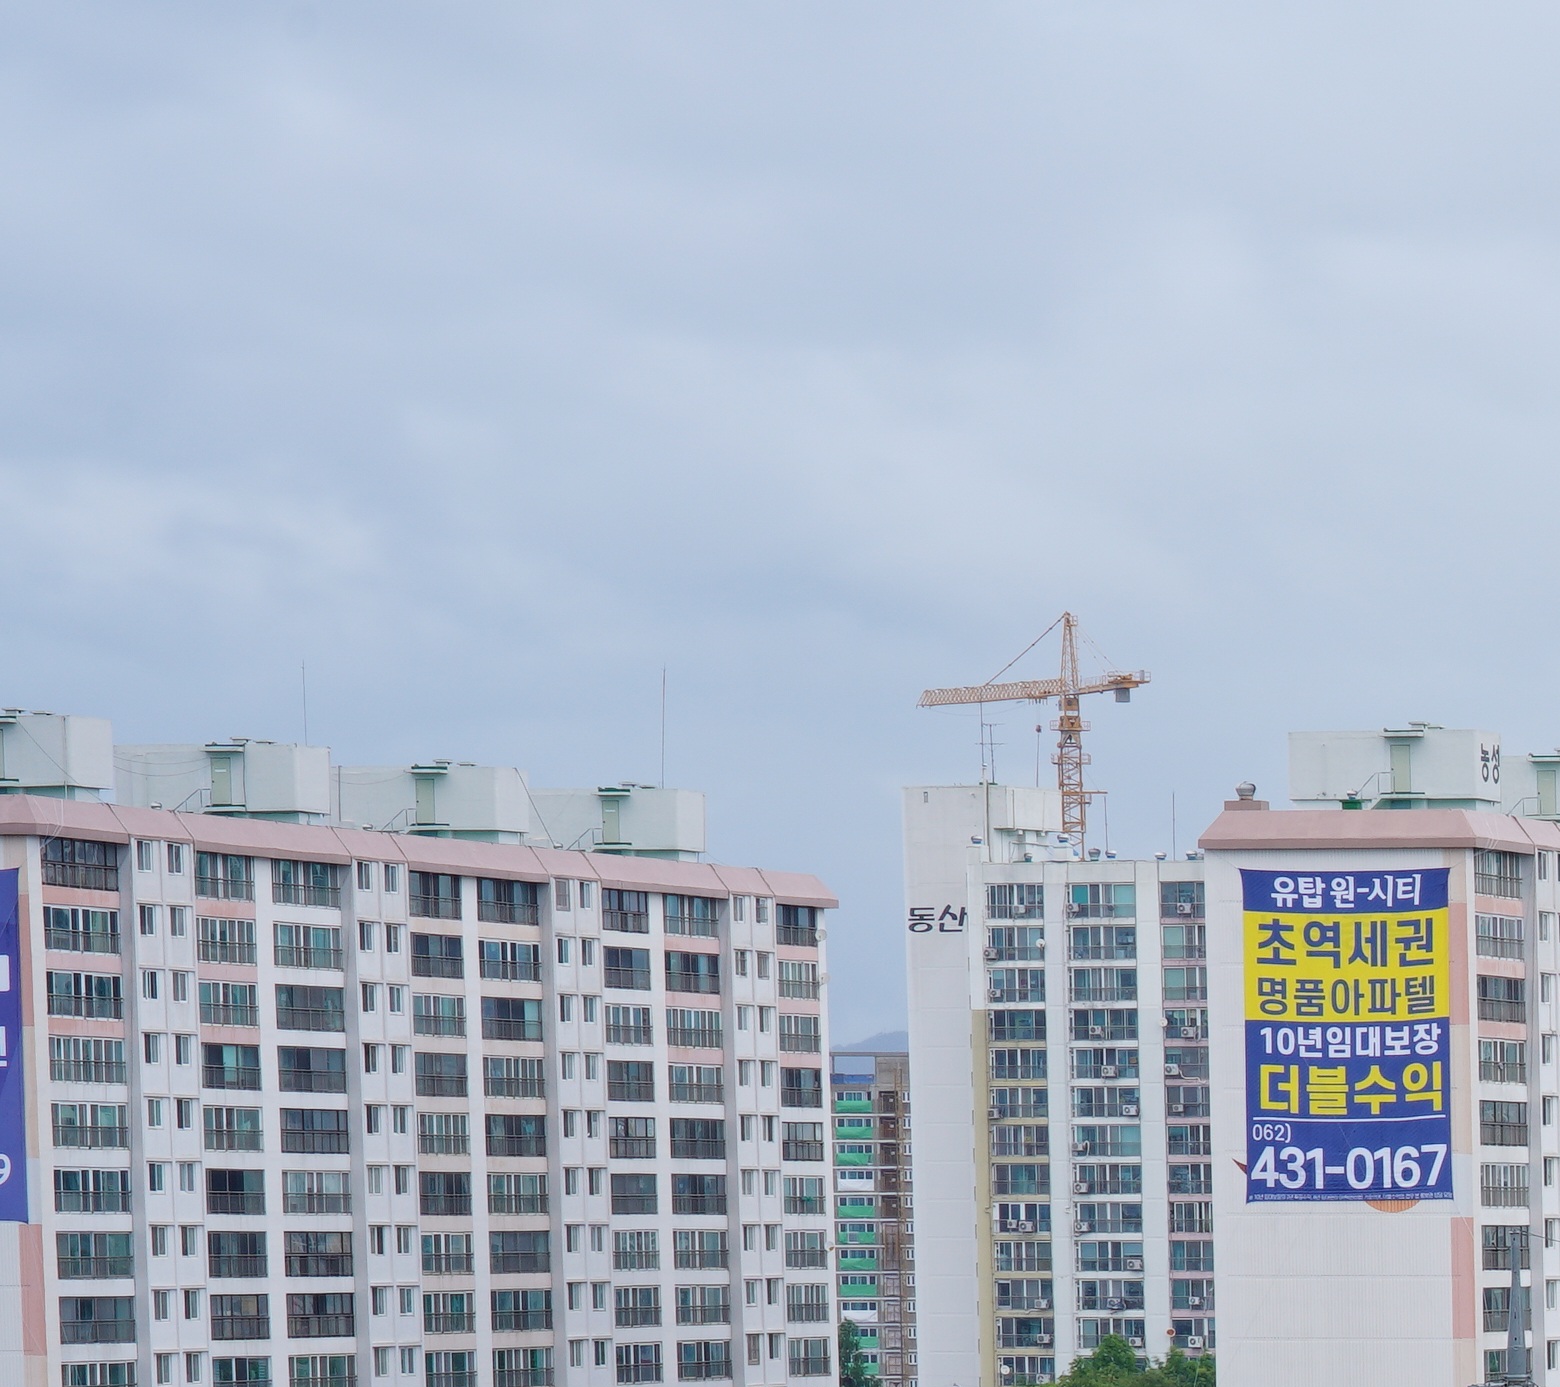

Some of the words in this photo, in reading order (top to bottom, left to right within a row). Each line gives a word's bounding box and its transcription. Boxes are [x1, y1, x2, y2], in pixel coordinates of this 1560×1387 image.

[1480, 743, 1500, 784] 농성
[1271, 875, 1326, 909] 유탑
[1330, 873, 1422, 908] 원-시티
[908, 904, 968, 933] 동산
[1257, 917, 1435, 969] 초역세권
[1257, 975, 1436, 1017] 명품아파텔
[1259, 1021, 1441, 1059] 10년임대보장
[1259, 1061, 1443, 1115] 더블수익
[1252, 1122, 1292, 1143] 062)
[1250, 1143, 1448, 1190] 431-0167
